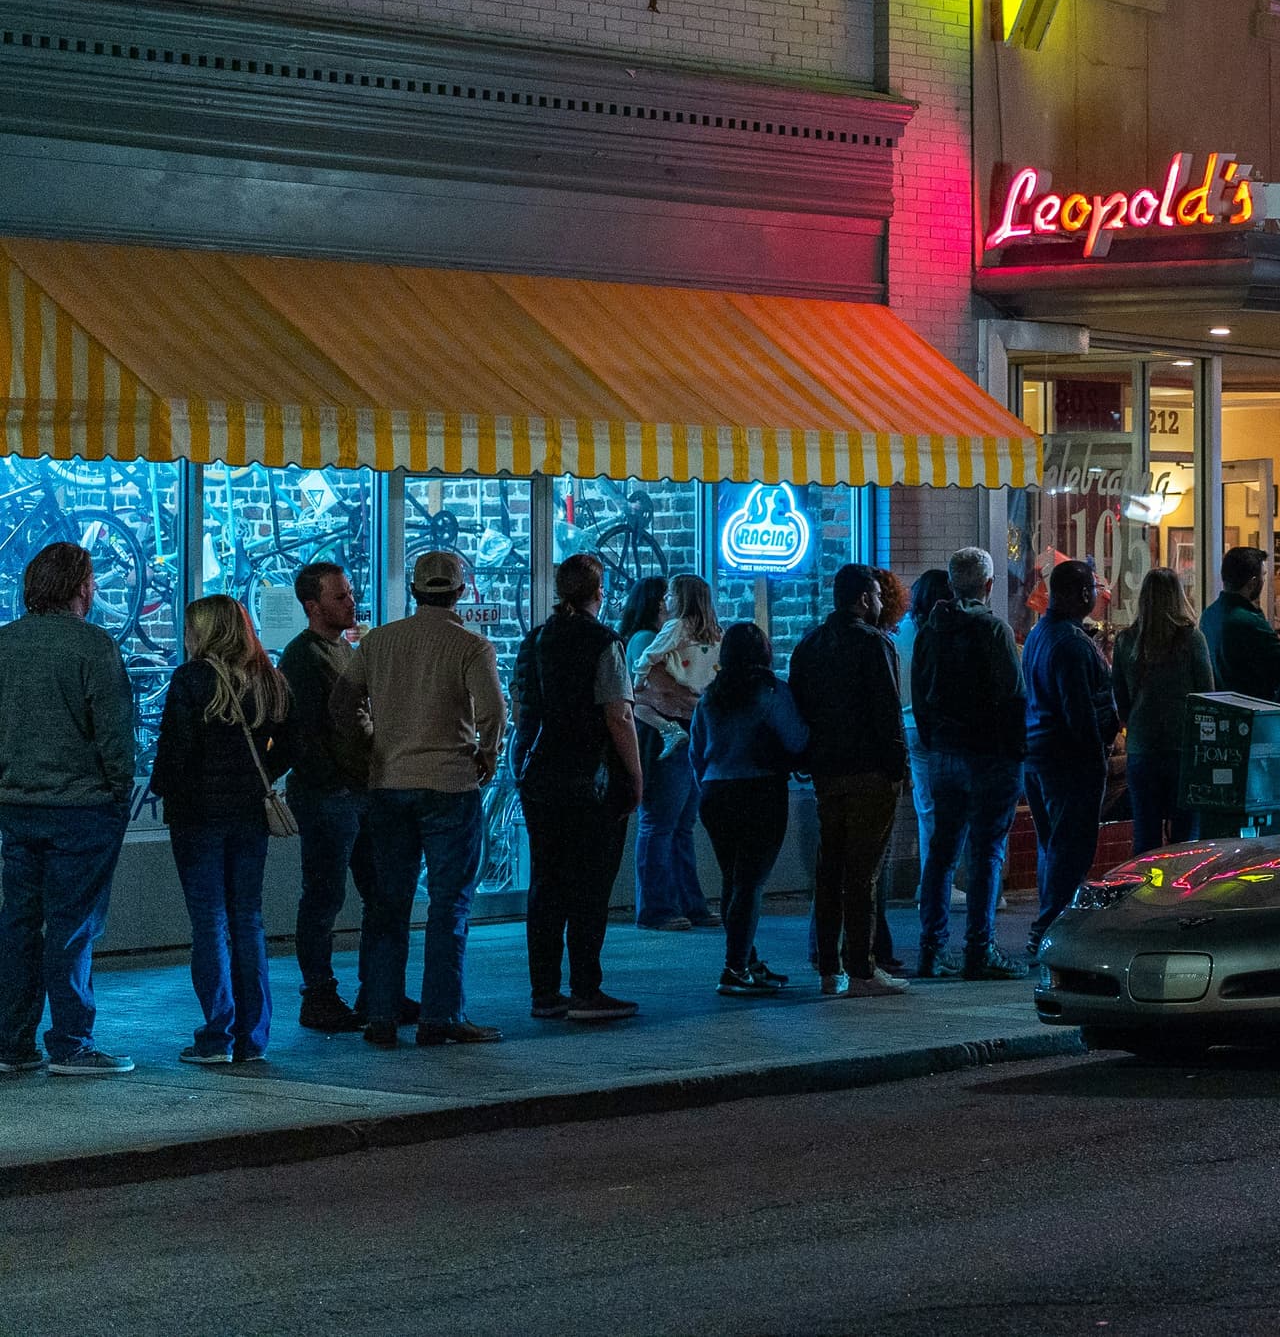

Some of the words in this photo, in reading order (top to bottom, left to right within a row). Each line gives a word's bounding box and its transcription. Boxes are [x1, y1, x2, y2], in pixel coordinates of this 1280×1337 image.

[985, 152, 1253, 258] Leopold's
[1149, 409, 1180, 435] 212
[741, 528, 794, 550] RACING
